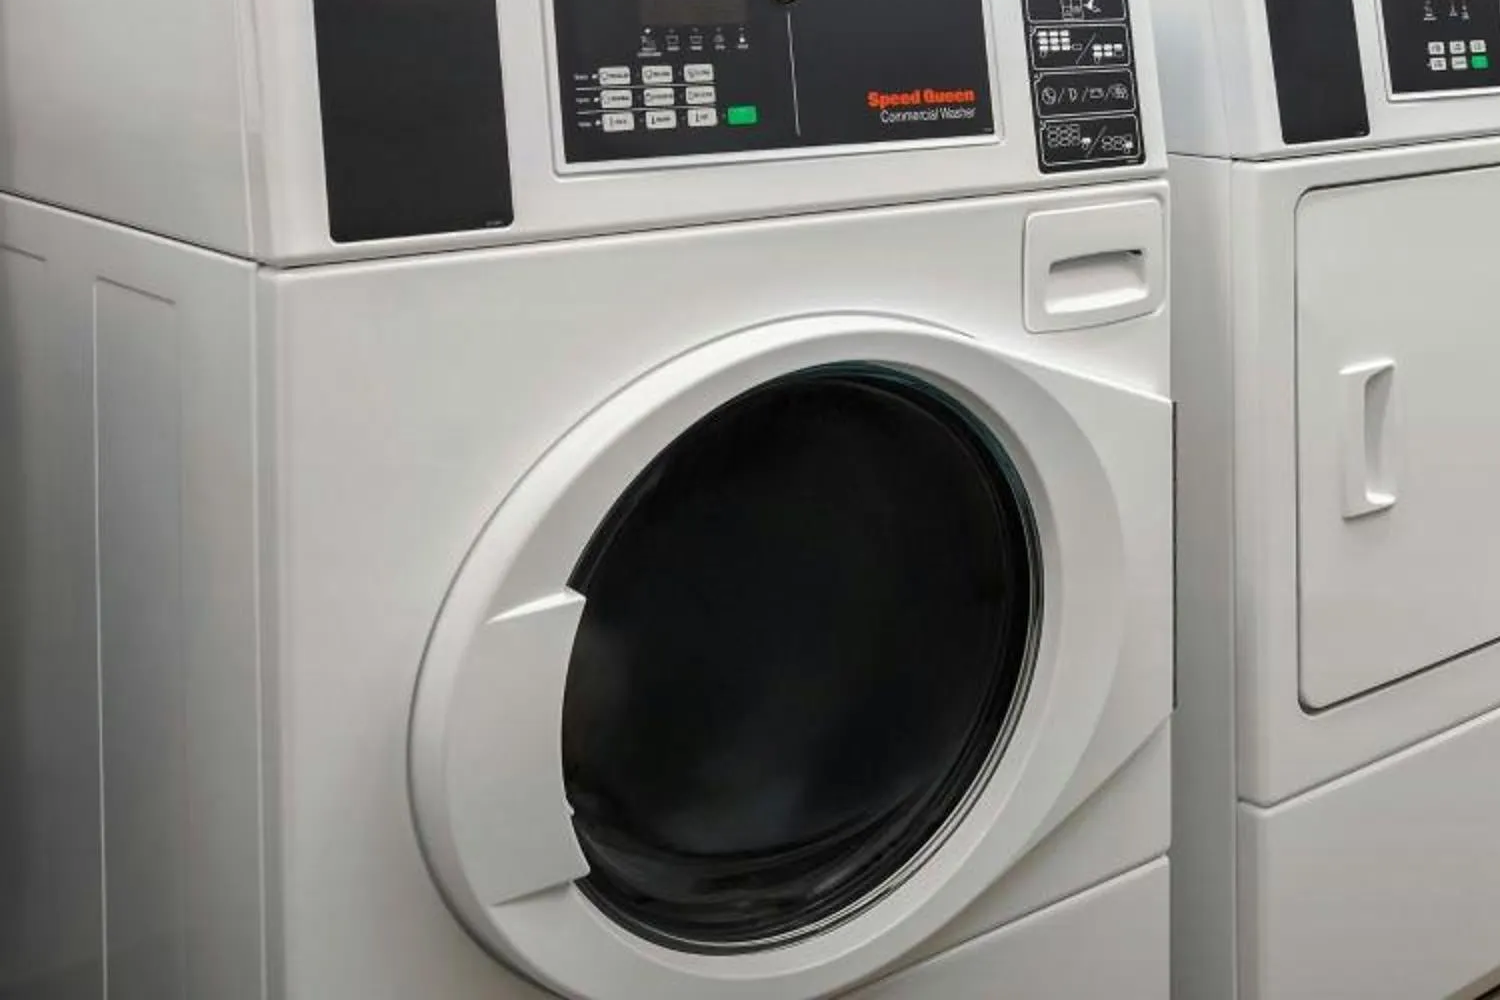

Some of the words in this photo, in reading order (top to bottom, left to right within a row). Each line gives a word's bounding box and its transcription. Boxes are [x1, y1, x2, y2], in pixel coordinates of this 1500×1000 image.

[867, 90, 920, 109] Speed
[923, 87, 976, 104] Queen
[880, 108, 939, 123] Commercial
[940, 106, 976, 120] Washer
